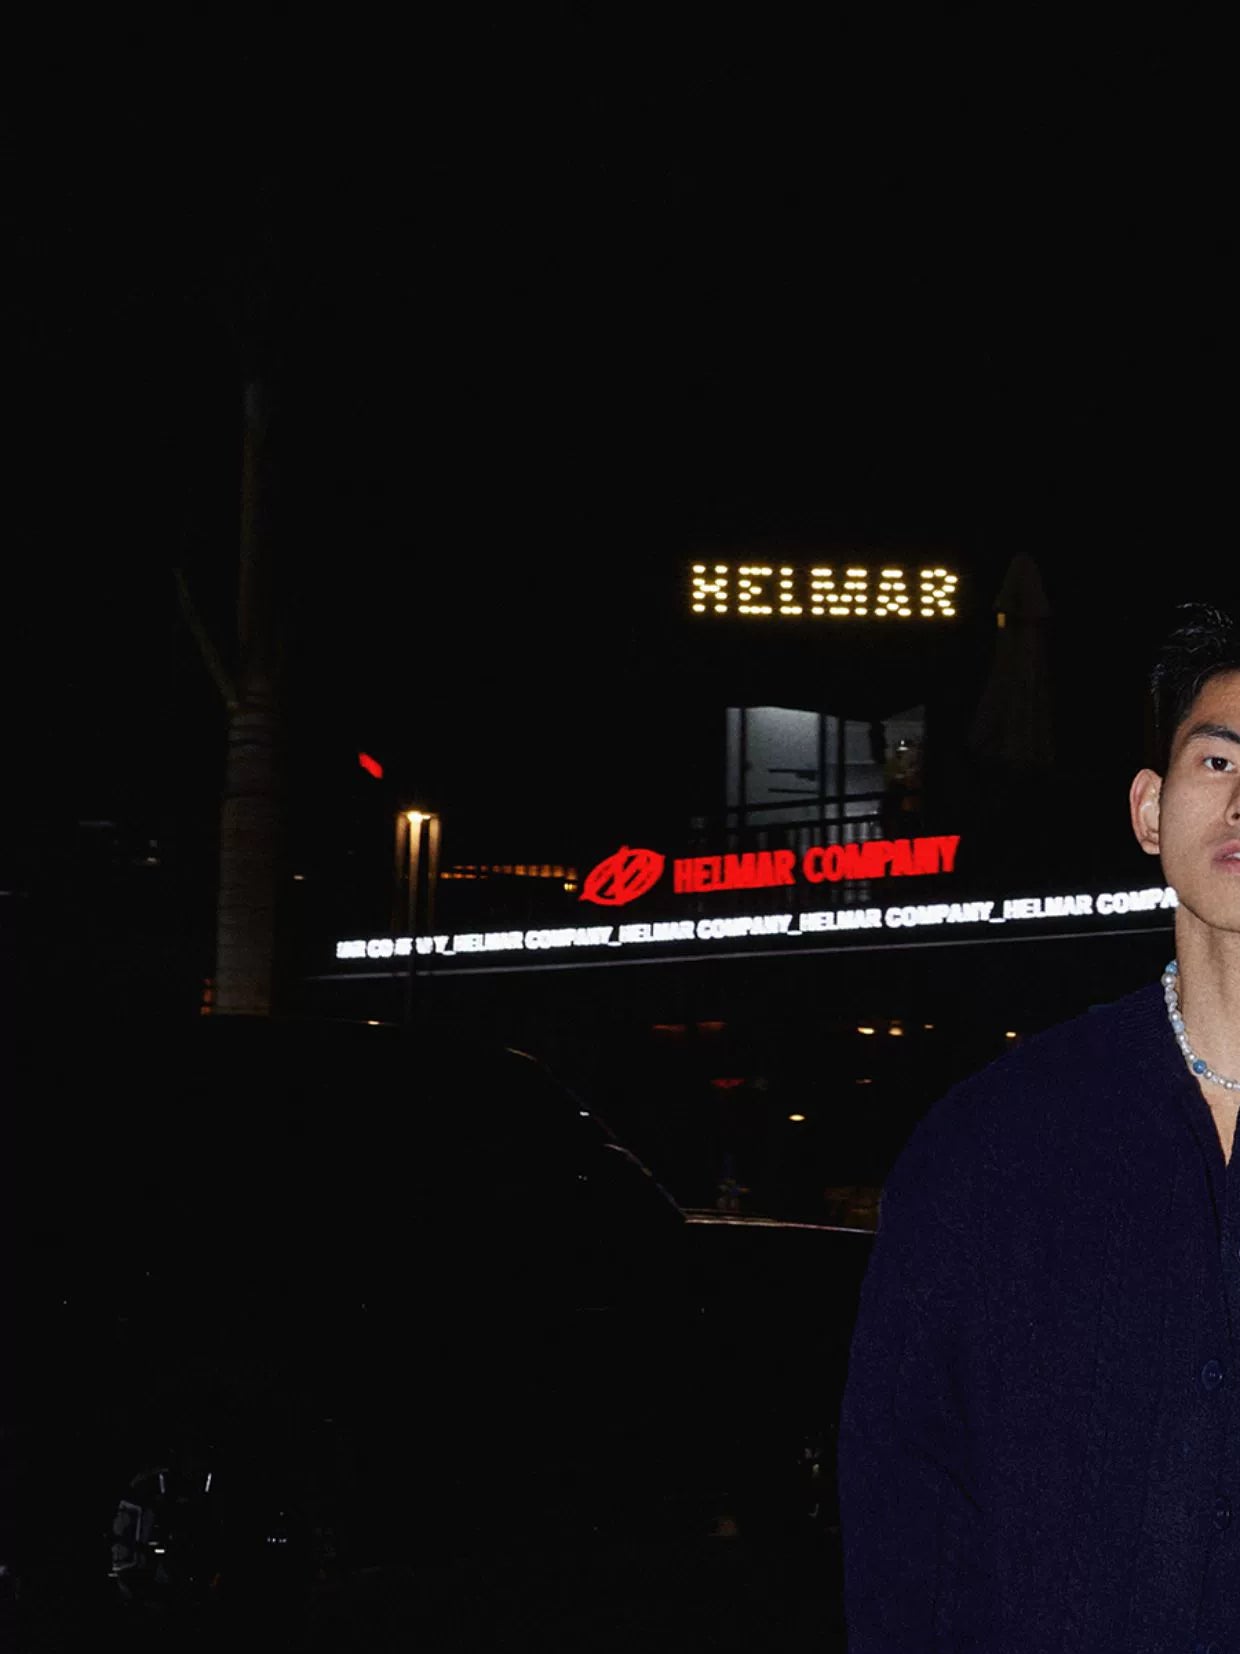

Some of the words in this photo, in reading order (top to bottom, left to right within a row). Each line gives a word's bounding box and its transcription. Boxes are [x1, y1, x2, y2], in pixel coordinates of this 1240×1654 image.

[692, 564, 957, 616] HELMAR
[673, 849, 796, 893] HELMAR
[802, 835, 960, 883] COMPANY
